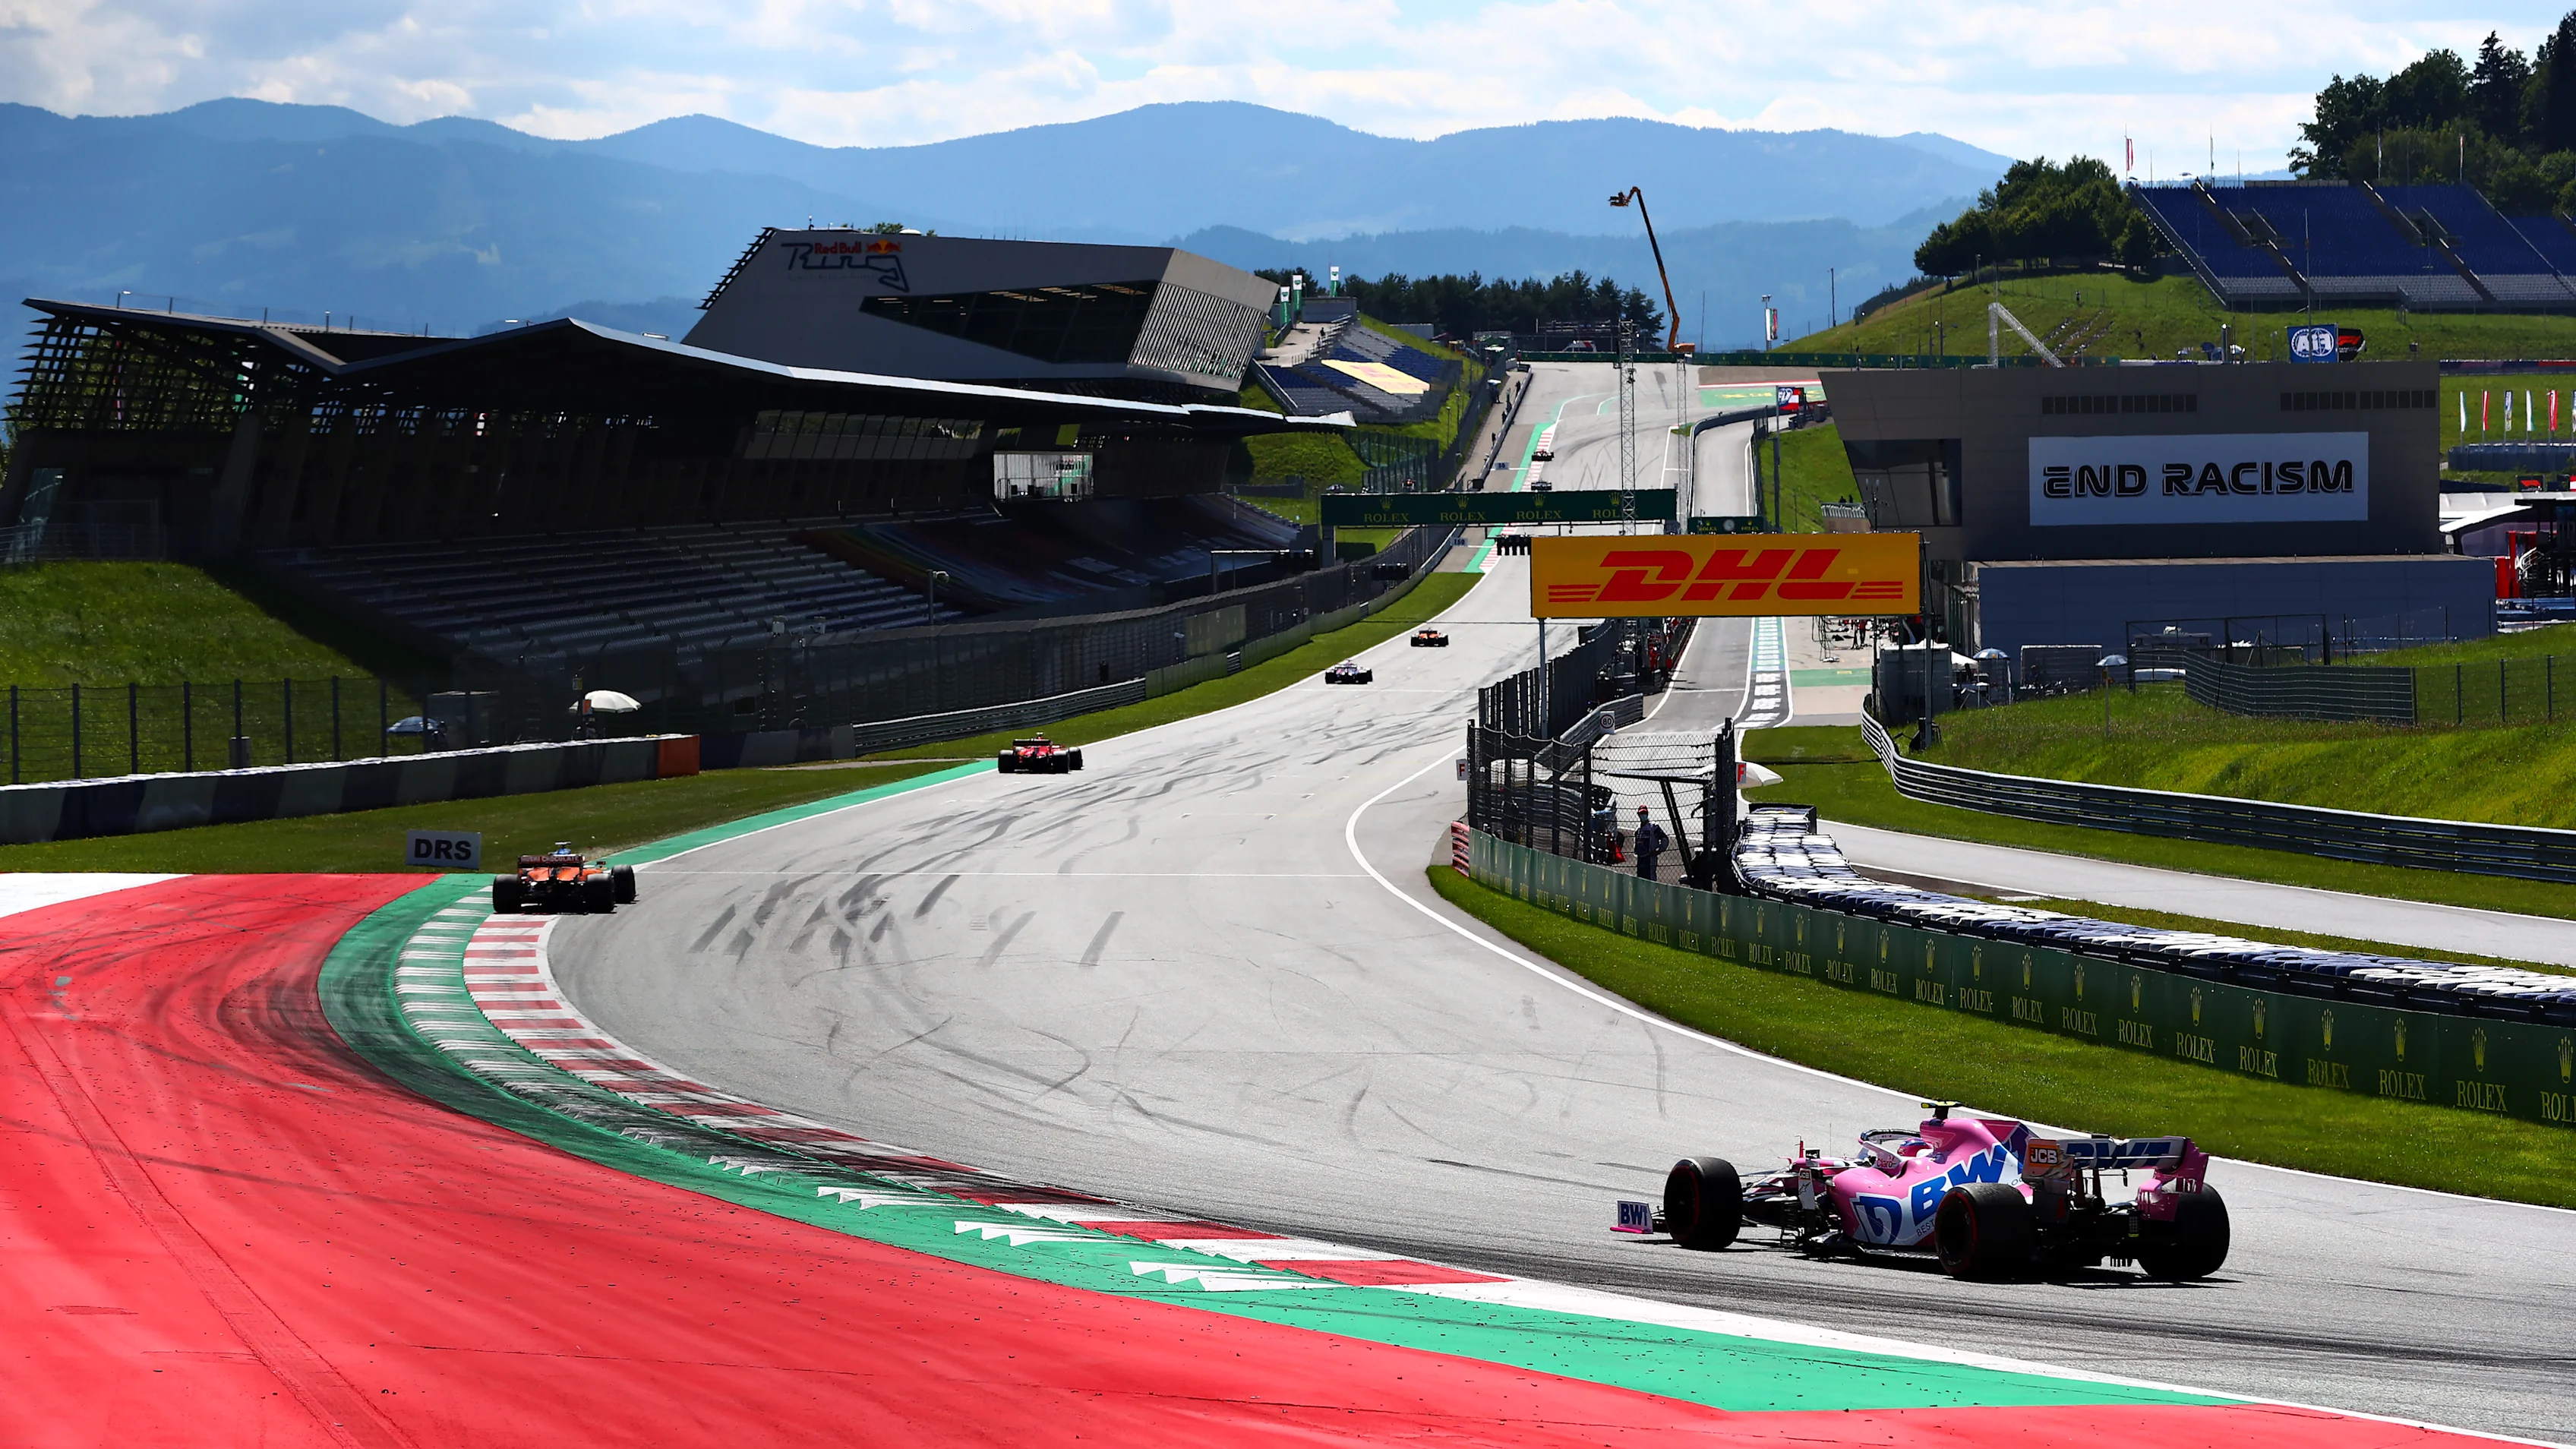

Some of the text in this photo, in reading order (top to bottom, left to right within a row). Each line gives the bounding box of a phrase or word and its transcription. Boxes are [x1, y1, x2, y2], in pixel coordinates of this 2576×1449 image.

[814, 242, 862, 254] Red Bull
[2043, 459, 2354, 498] END RACISM
[1364, 513, 1410, 523] ROLEX
[1440, 512, 1486, 522] ROLEX
[1516, 510, 1562, 520] ROLEX
[1593, 508, 1639, 519] ROL
[1596, 548, 1856, 601] DHL
[1459, 763, 1466, 777] F
[1738, 764, 1745, 782] F
[414, 838, 472, 860] DRS
[1648, 922, 1668, 944] ROLEX
[1678, 929, 1700, 952] ROLEX
[1711, 936, 1736, 958] ROLEX
[1748, 942, 1773, 965] ROLEX
[1785, 951, 1811, 975] ROLEX
[1826, 959, 1854, 984] ROLEX
[1870, 968, 1898, 994] ROLEX
[1915, 978, 1945, 1005] ROLEX
[1959, 987, 1994, 1013] ROLEX
[2012, 996, 2044, 1024] ROLEX
[2062, 1006, 2098, 1036] ROLEX
[2117, 1018, 2154, 1049] ROLEX
[2176, 1031, 2215, 1064] ROLEX
[2240, 1045, 2278, 1078] ROLEX
[2307, 1058, 2350, 1090] ROLEX
[2379, 1069, 2427, 1101] ROLEX
[2456, 1080, 2508, 1113] ROLEX
[2031, 1148, 2059, 1164] JCB
[2065, 1141, 2171, 1170] BWT
[1620, 1203, 1648, 1226] BWT
[1916, 1218, 1935, 1237] BEST
